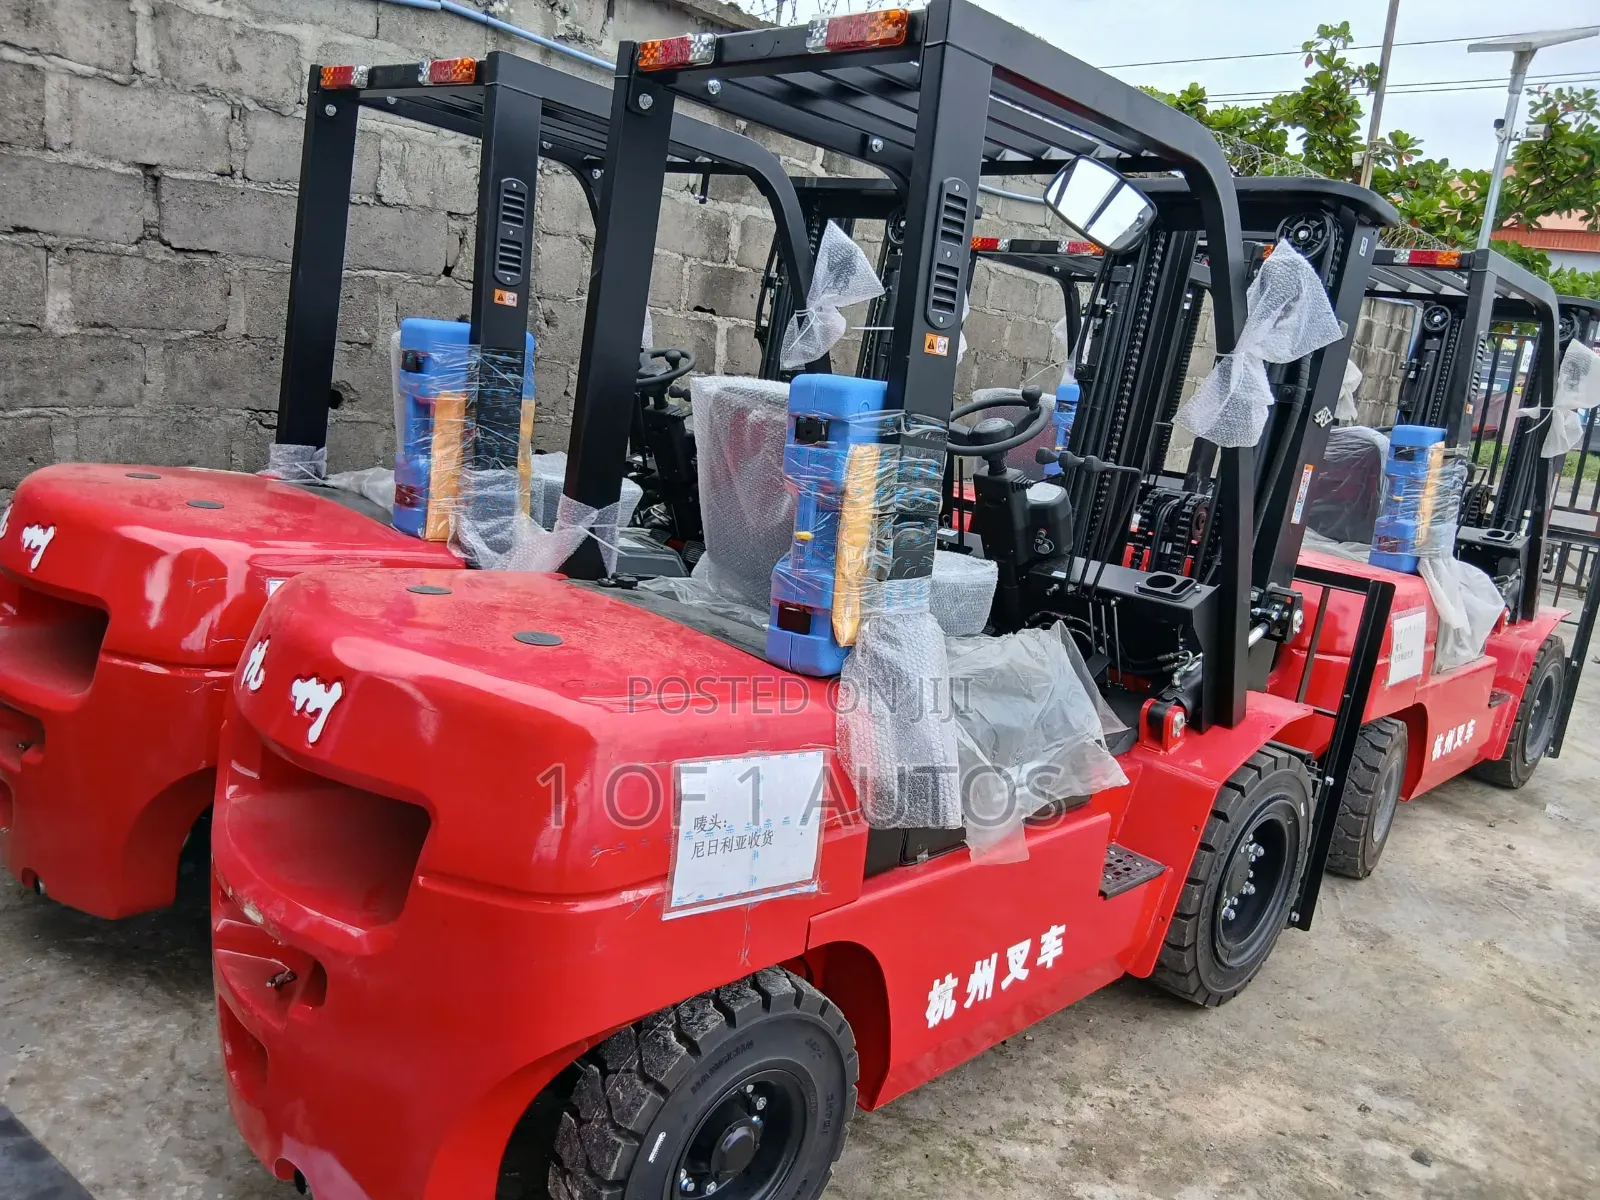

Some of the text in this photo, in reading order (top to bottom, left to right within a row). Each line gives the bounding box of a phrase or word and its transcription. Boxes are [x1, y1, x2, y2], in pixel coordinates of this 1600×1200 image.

[690, 829, 774, 861] 尼日利亚收货
[925, 923, 1067, 1029] 杭州叉车
